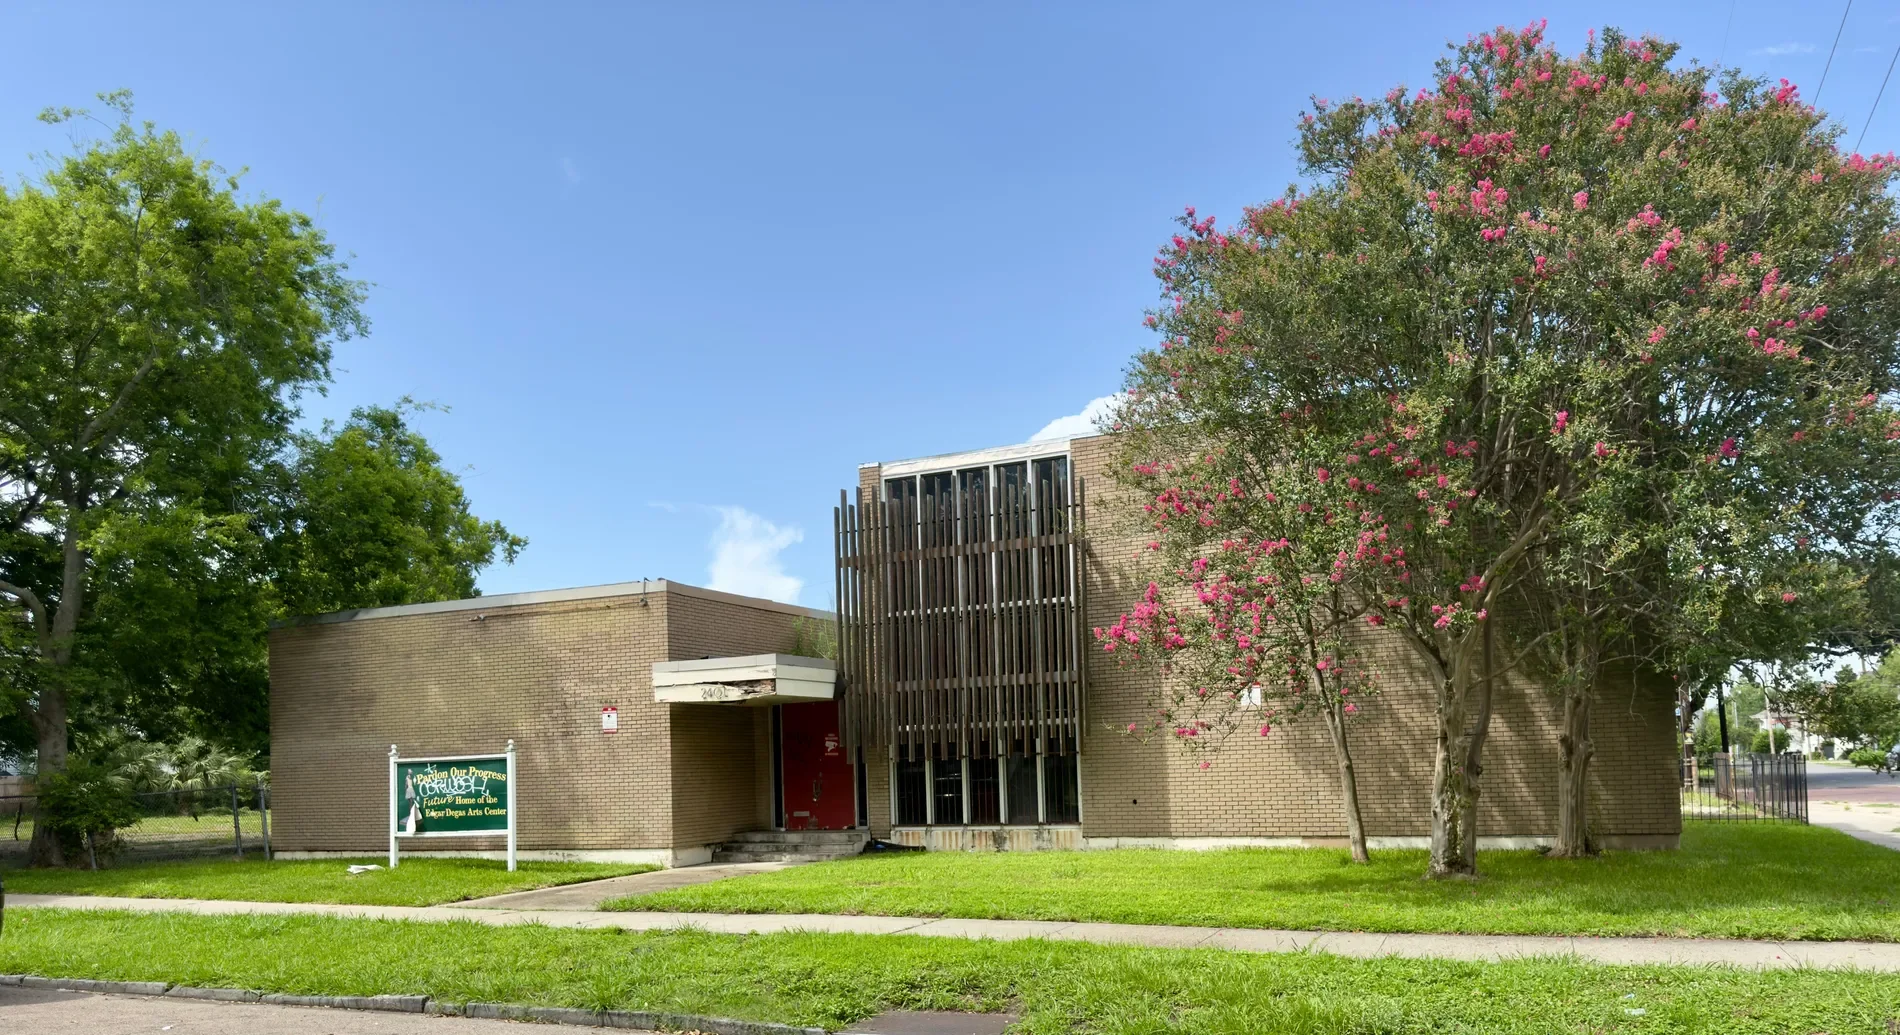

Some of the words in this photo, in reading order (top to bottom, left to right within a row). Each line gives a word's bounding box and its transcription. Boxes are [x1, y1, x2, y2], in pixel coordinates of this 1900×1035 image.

[416, 770, 448, 785] Pardon
[450, 766, 467, 778] Our
[469, 766, 507, 782] Progress
[423, 795, 454, 808] Future
[455, 795, 476, 805] Home
[477, 795, 485, 804] of
[486, 794, 498, 804] the
[425, 807, 445, 819] Edgar
[446, 807, 466, 819] Degas
[467, 807, 483, 816] Arts
[484, 806, 507, 816] Center
